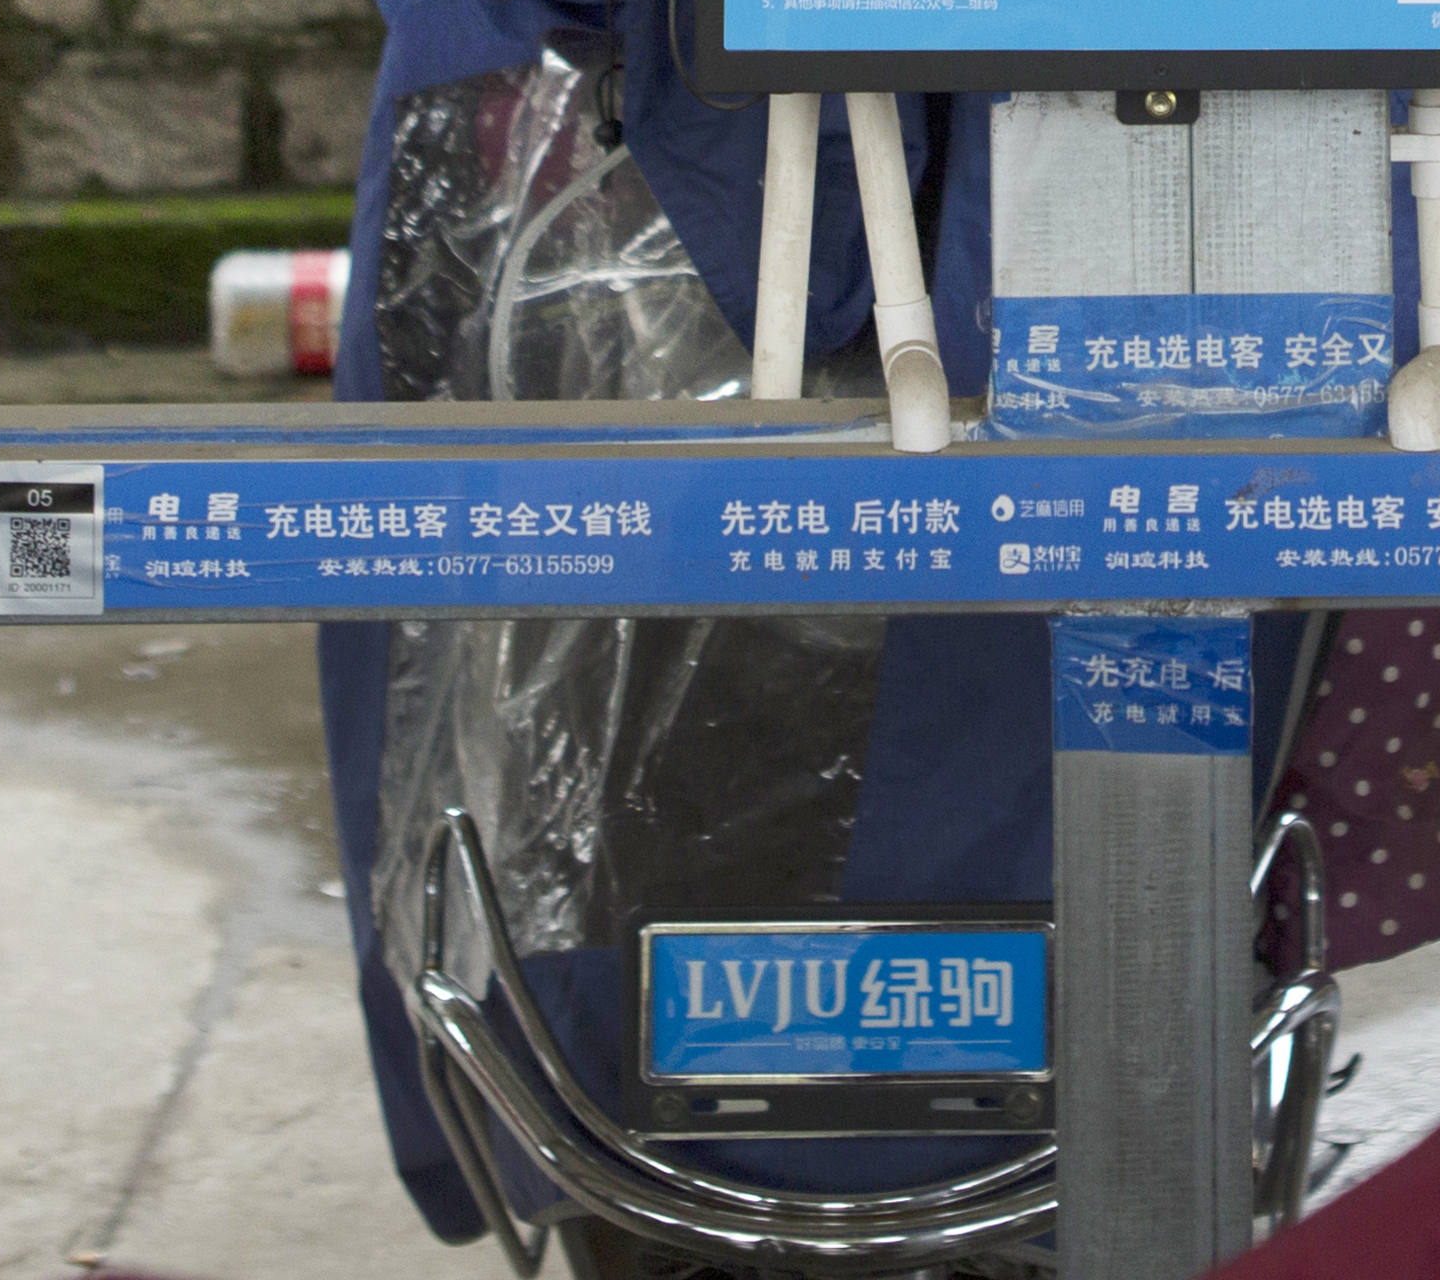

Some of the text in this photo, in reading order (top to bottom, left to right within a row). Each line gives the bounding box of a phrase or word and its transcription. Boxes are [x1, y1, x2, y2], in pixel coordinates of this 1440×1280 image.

[1085, 331, 1391, 371] 充电选电客 安全又
[27, 489, 53, 507] 05
[1018, 499, 1085, 518] 芝麻信用
[1224, 493, 1406, 531] 充电选电客
[265, 500, 653, 539] 充电选电客 安全又省钱
[720, 498, 961, 536] 先充电 后付款
[729, 548, 952, 572] 充电就用支付宝
[1032, 545, 1082, 563] 支付宝
[1086, 653, 1192, 690] 先充电
[686, 957, 1014, 1033] LVJU 绿驹
